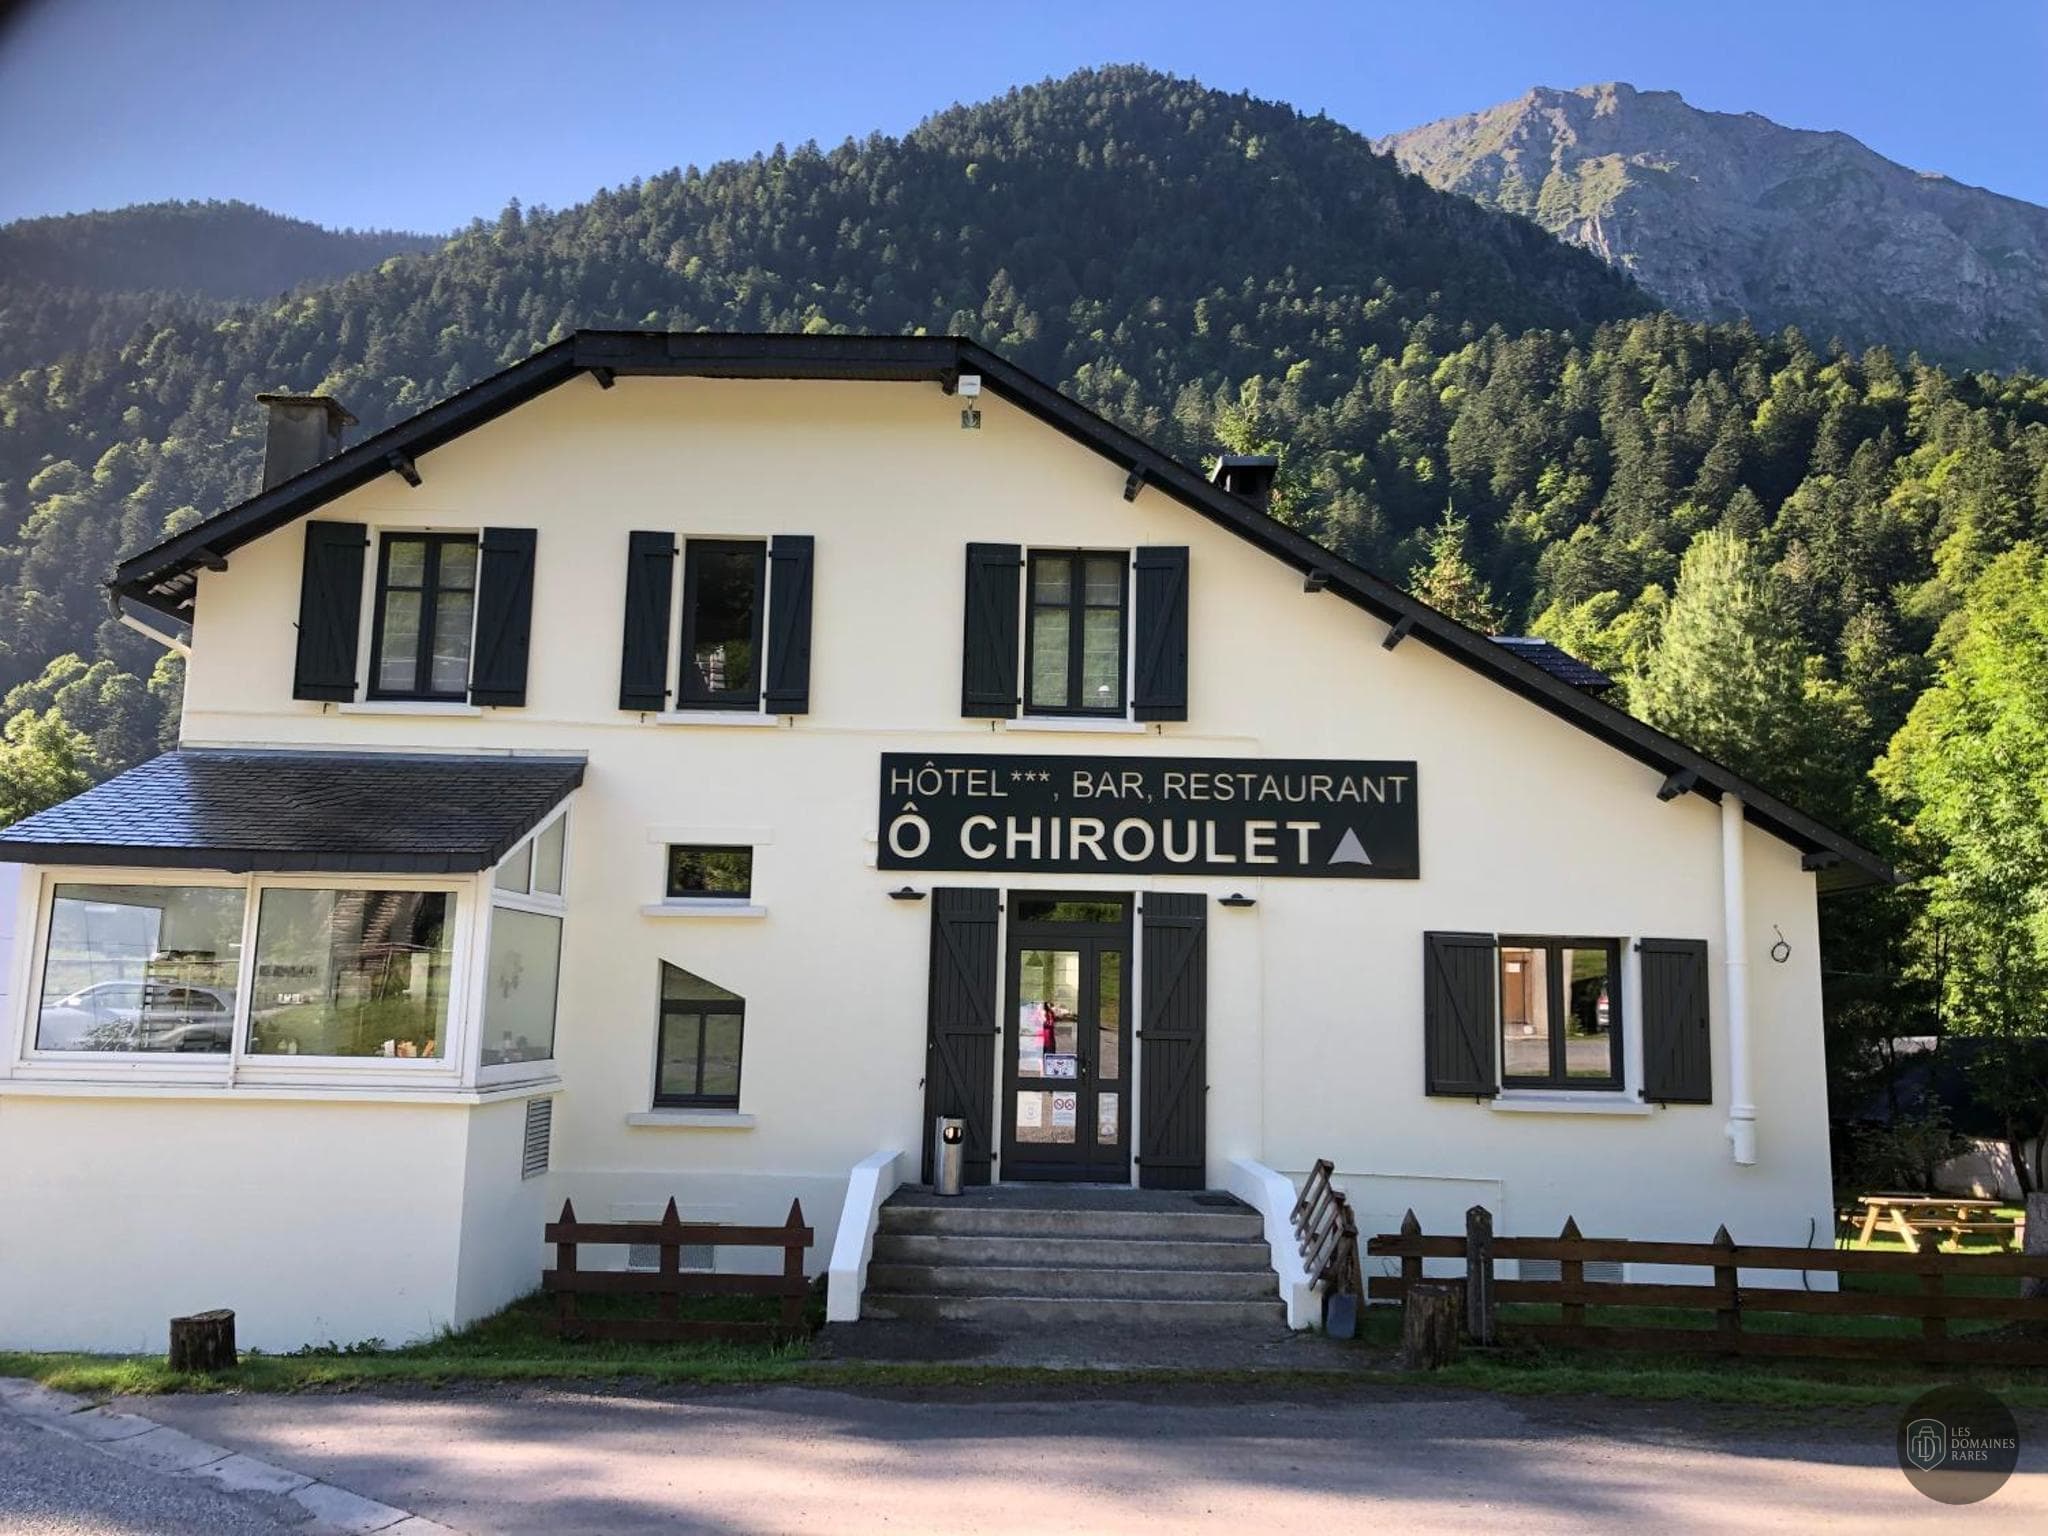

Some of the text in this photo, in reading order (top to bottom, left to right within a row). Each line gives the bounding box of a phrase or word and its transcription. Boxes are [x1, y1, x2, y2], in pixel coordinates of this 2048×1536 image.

[1072, 770, 1153, 803] BAR,
[1163, 771, 1410, 804] RESTAURANT
[888, 801, 1321, 865] Ô CHIROULET
